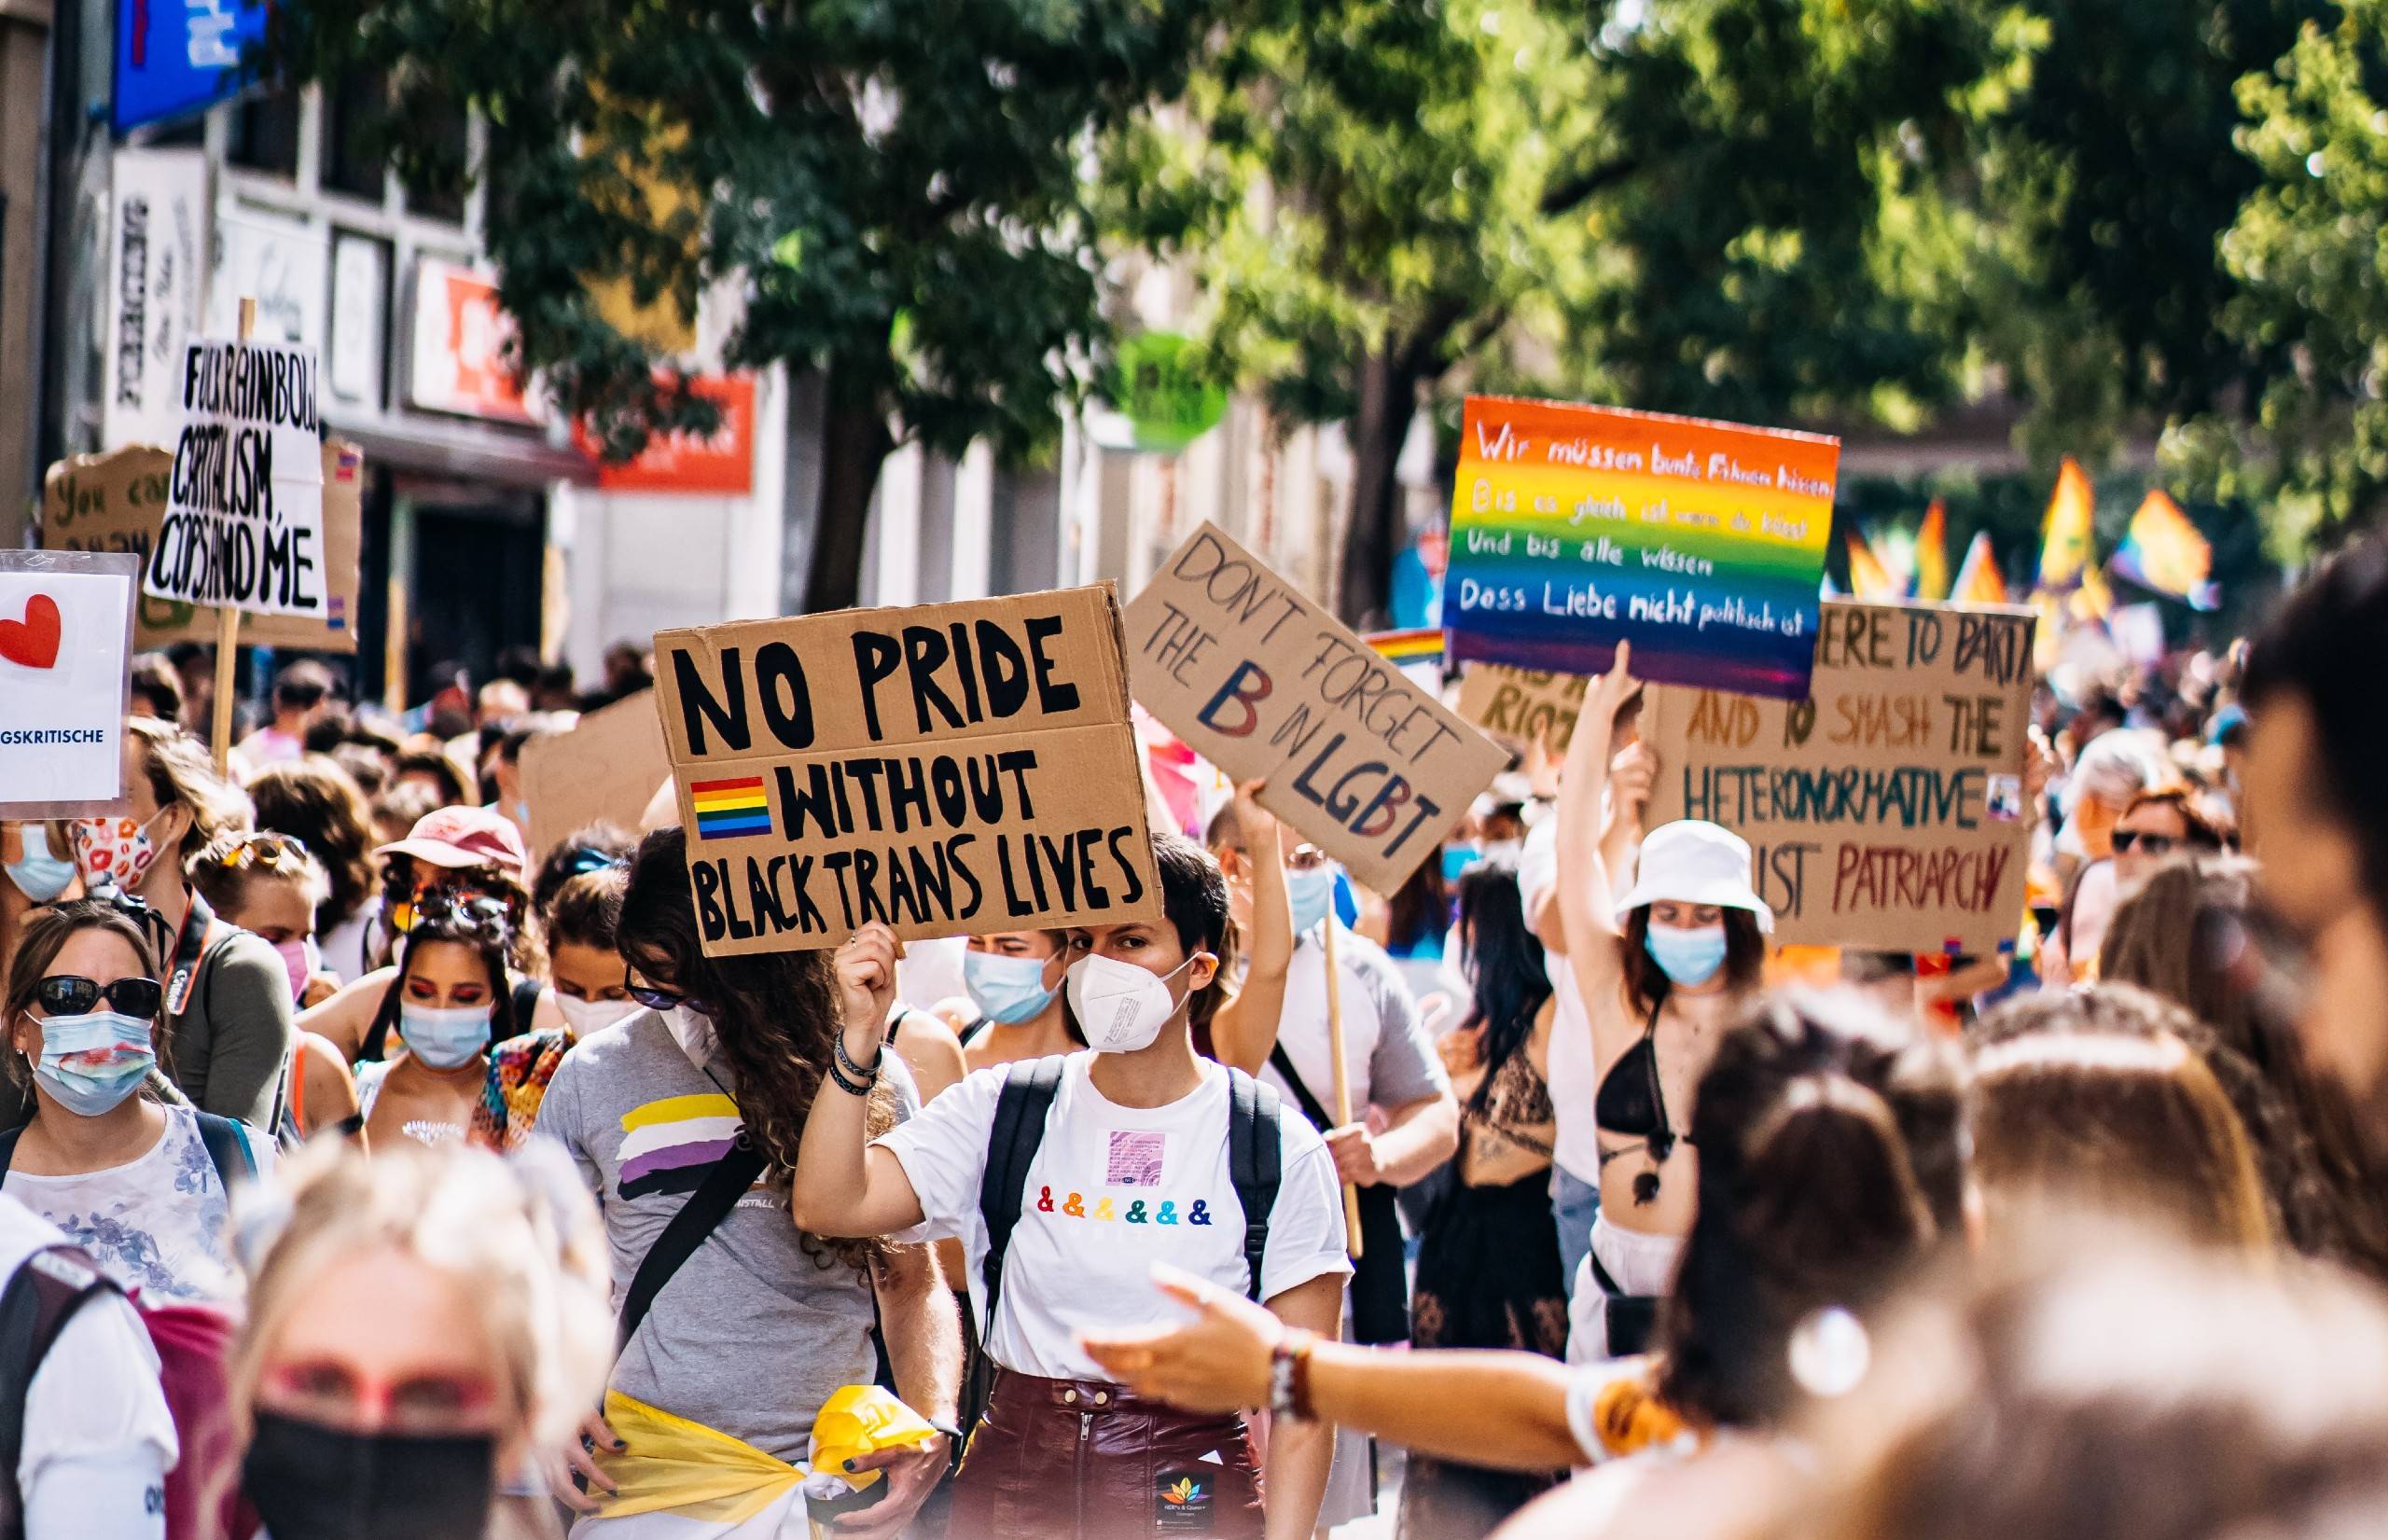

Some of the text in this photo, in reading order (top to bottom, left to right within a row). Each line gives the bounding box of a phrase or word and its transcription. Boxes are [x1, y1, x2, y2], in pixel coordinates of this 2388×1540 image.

[223, 343, 316, 434] RAINBOW
[1476, 419, 1531, 463] Wir
[1547, 437, 1645, 471] müssen
[1650, 441, 1703, 479] bunte
[1707, 451, 1772, 487] Fahnen
[55, 473, 106, 529] You
[1471, 477, 1518, 514] Bis
[1534, 494, 1559, 513] es
[1566, 492, 1628, 527] gleich
[1640, 496, 1669, 523] ist
[258, 523, 318, 608] ME
[1467, 527, 1715, 577] Und bis alle wissen
[1460, 576, 1804, 638] Dass Liebe nicht politisch ist
[1815, 607, 1895, 669] ERE
[1900, 606, 1943, 671] TO
[1173, 532, 1463, 766] DON'T FORGET
[671, 615, 1081, 756] NO PRIDE
[1479, 683, 1580, 752] RIOT
[0, 729, 104, 744] GSKRITISCHE
[1144, 601, 1442, 860] THE B IN LGBT
[1687, 685, 1761, 747] AND
[1826, 691, 1932, 747] SMASH
[1942, 693, 2005, 758] THE
[774, 749, 1038, 841] WITHOUT
[1683, 763, 1986, 830] HETERONORMATIVE
[690, 825, 1144, 942] BLACK TRANS LIVES
[734, 1199, 775, 1209] NSTALL
